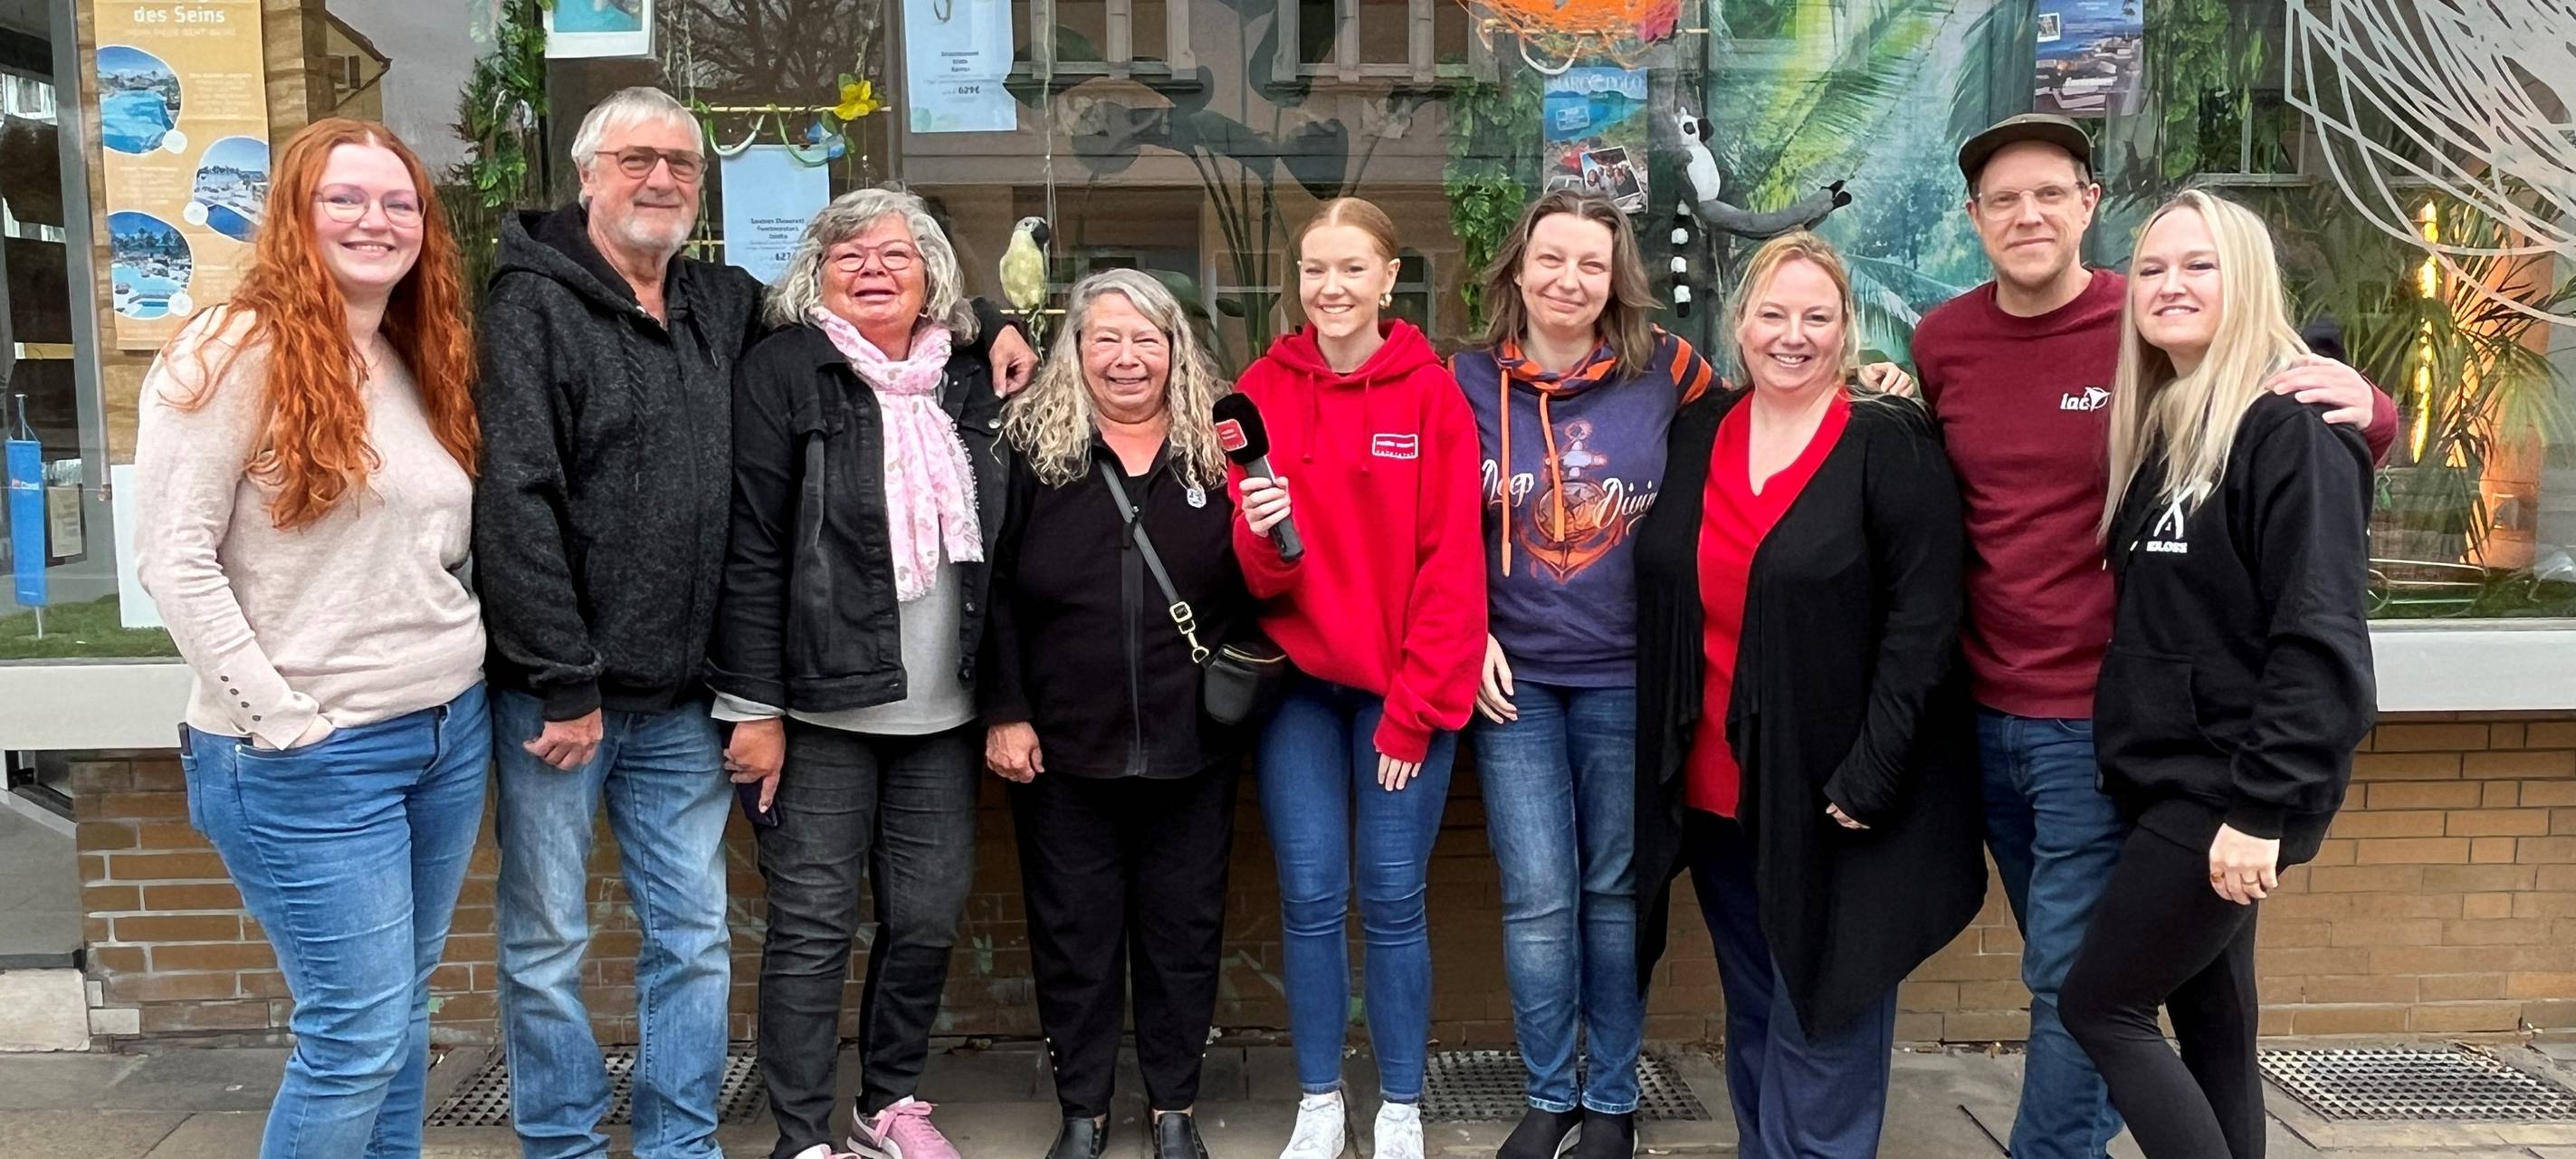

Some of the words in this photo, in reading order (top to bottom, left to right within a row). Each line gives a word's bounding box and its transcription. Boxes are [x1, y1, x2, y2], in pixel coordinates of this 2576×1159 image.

[133, 5, 167, 23] des
[173, 5, 225, 24] Seins
[775, 252, 795, 262] 627
